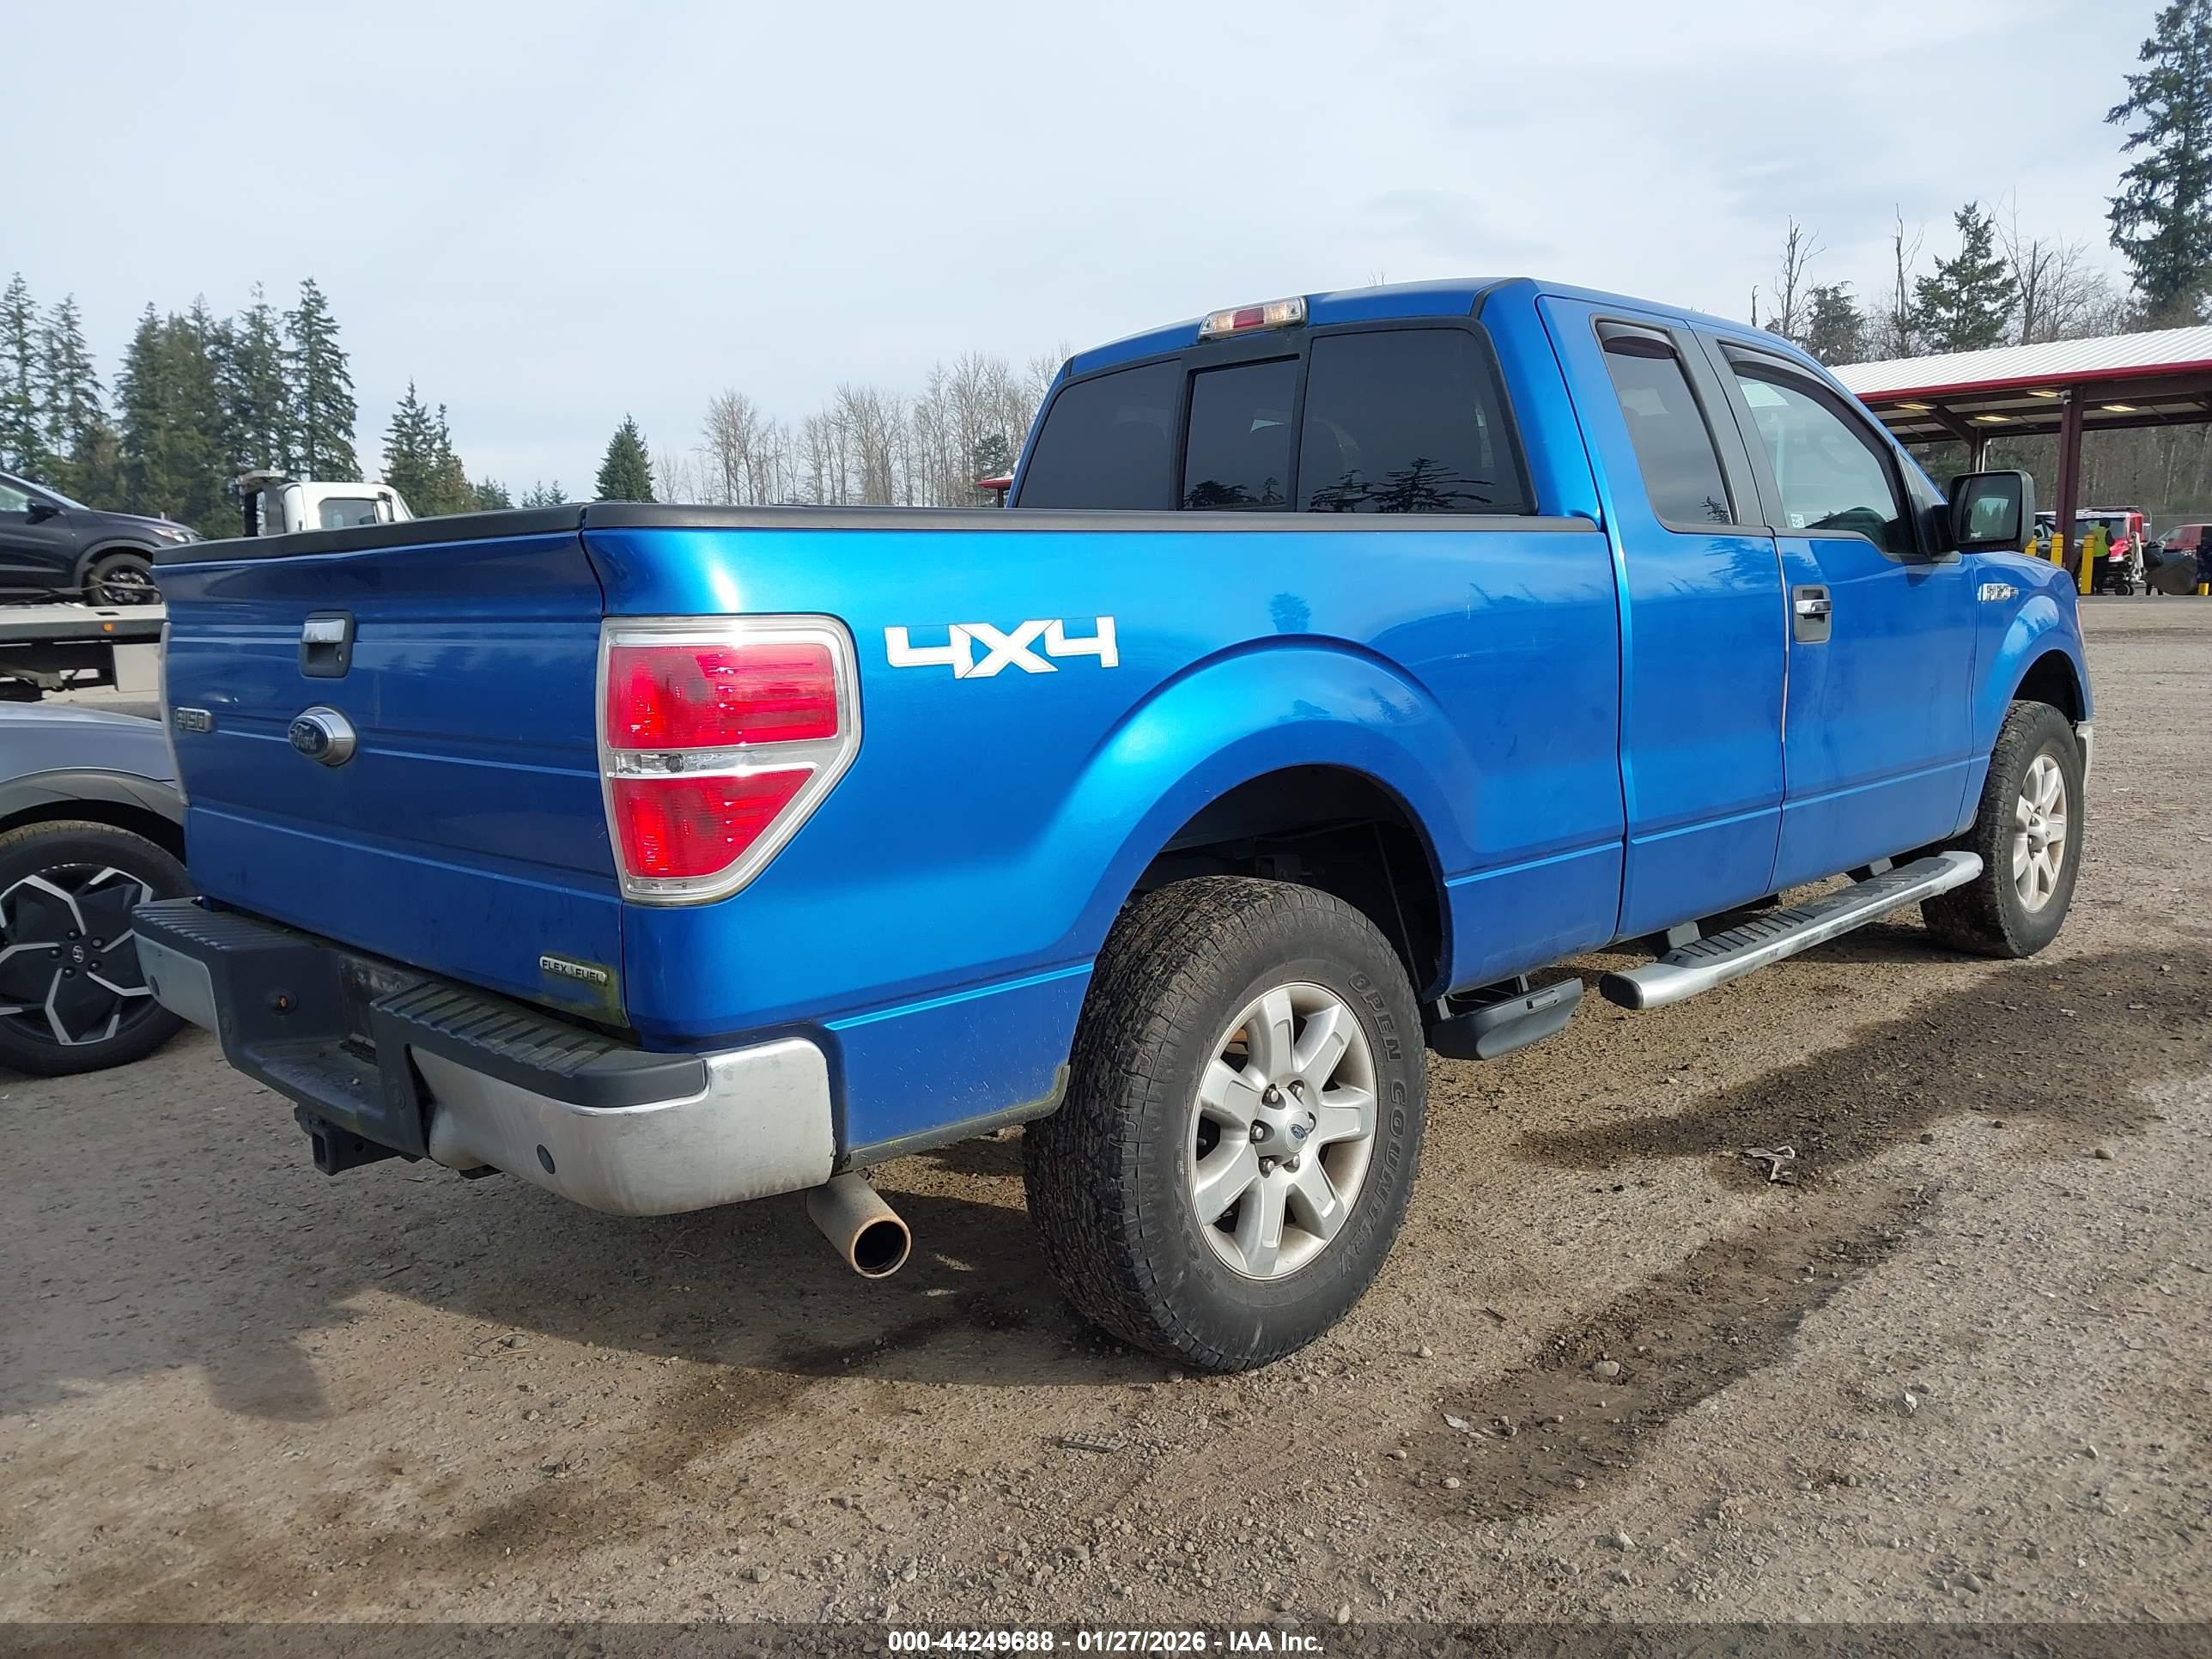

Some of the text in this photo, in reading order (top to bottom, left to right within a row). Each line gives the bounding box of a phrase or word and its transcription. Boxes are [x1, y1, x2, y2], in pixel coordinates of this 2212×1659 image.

[883, 615, 1120, 679] 4X4
[291, 722, 318, 750] Ford
[541, 959, 603, 983] FLEX FUEL
[1340, 972, 1407, 1278] OPEN COUNTRY
